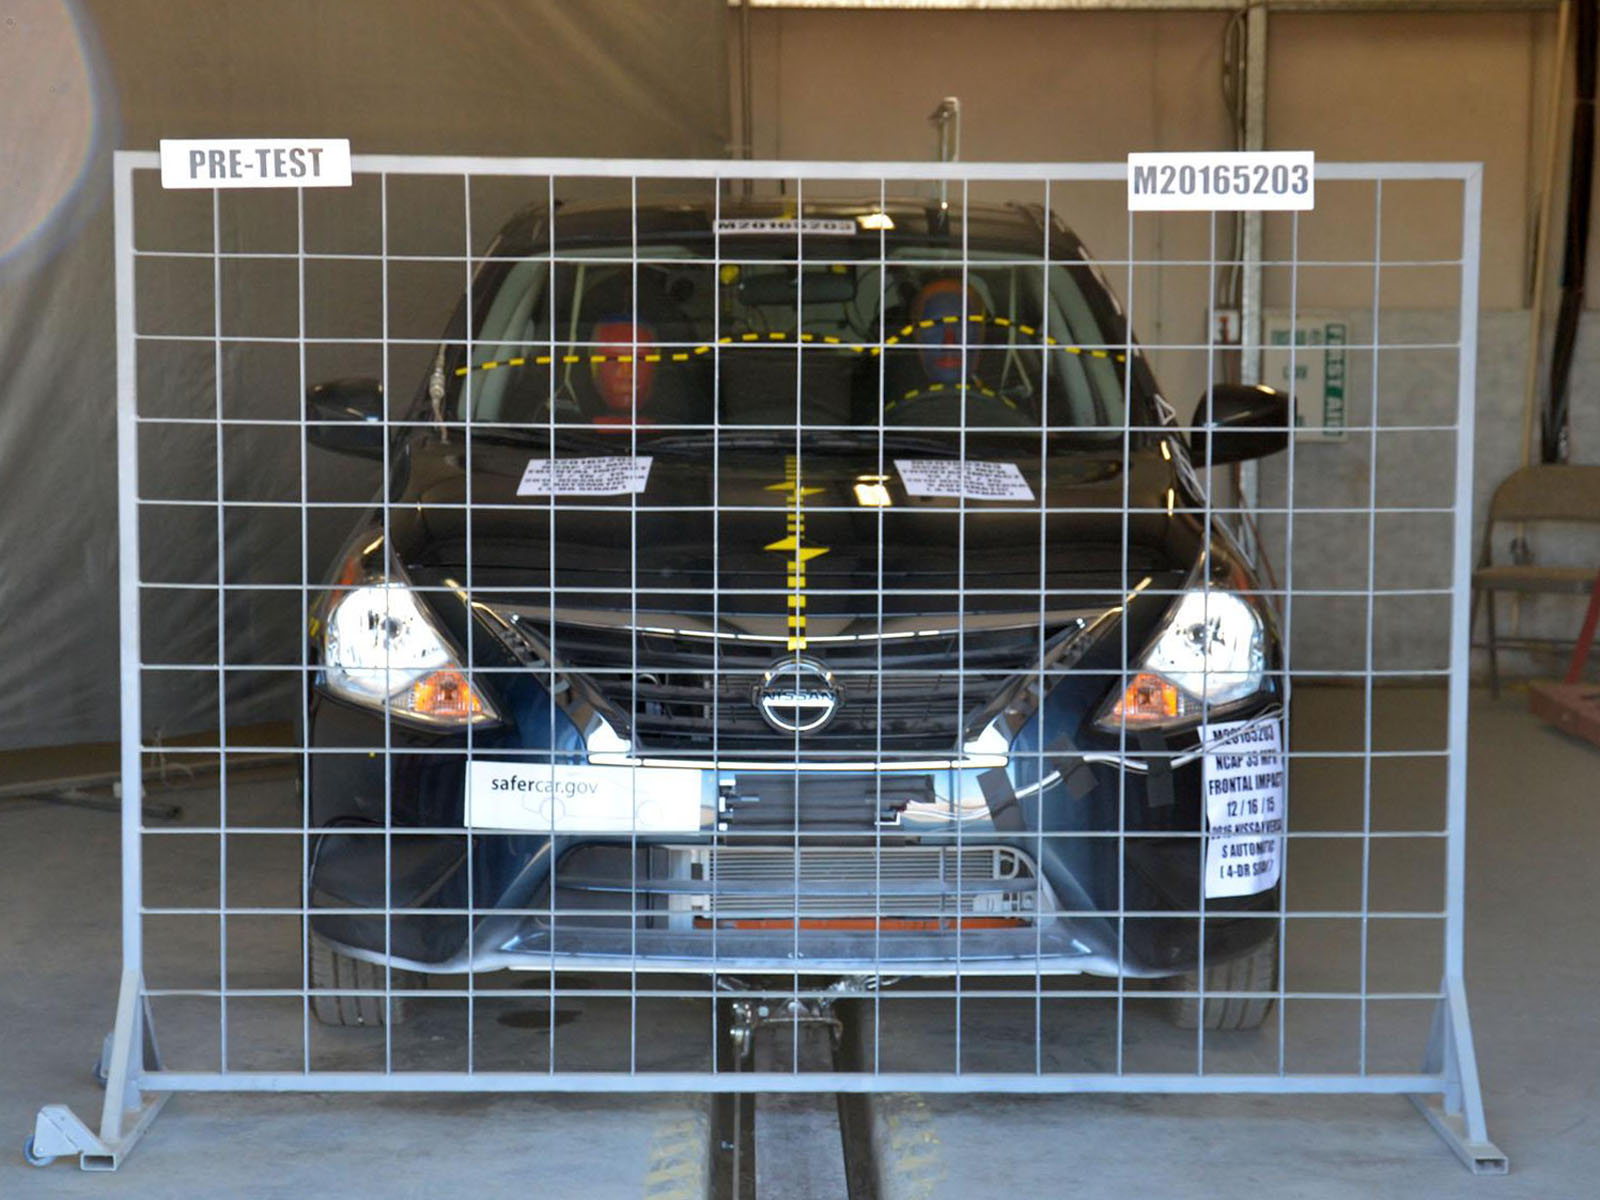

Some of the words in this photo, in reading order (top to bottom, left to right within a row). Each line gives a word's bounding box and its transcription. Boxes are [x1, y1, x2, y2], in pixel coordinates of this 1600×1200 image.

[189, 148, 323, 179] PRE-TEST
[1133, 164, 1309, 195] M20165203
[1215, 753, 1243, 770] NCAP
[491, 775, 598, 798] safercar.gov
[1208, 775, 1253, 795] FRONTAL
[1227, 801, 1238, 817] 12
[1247, 798, 1258, 814] 16
[1222, 845, 1228, 858] S
